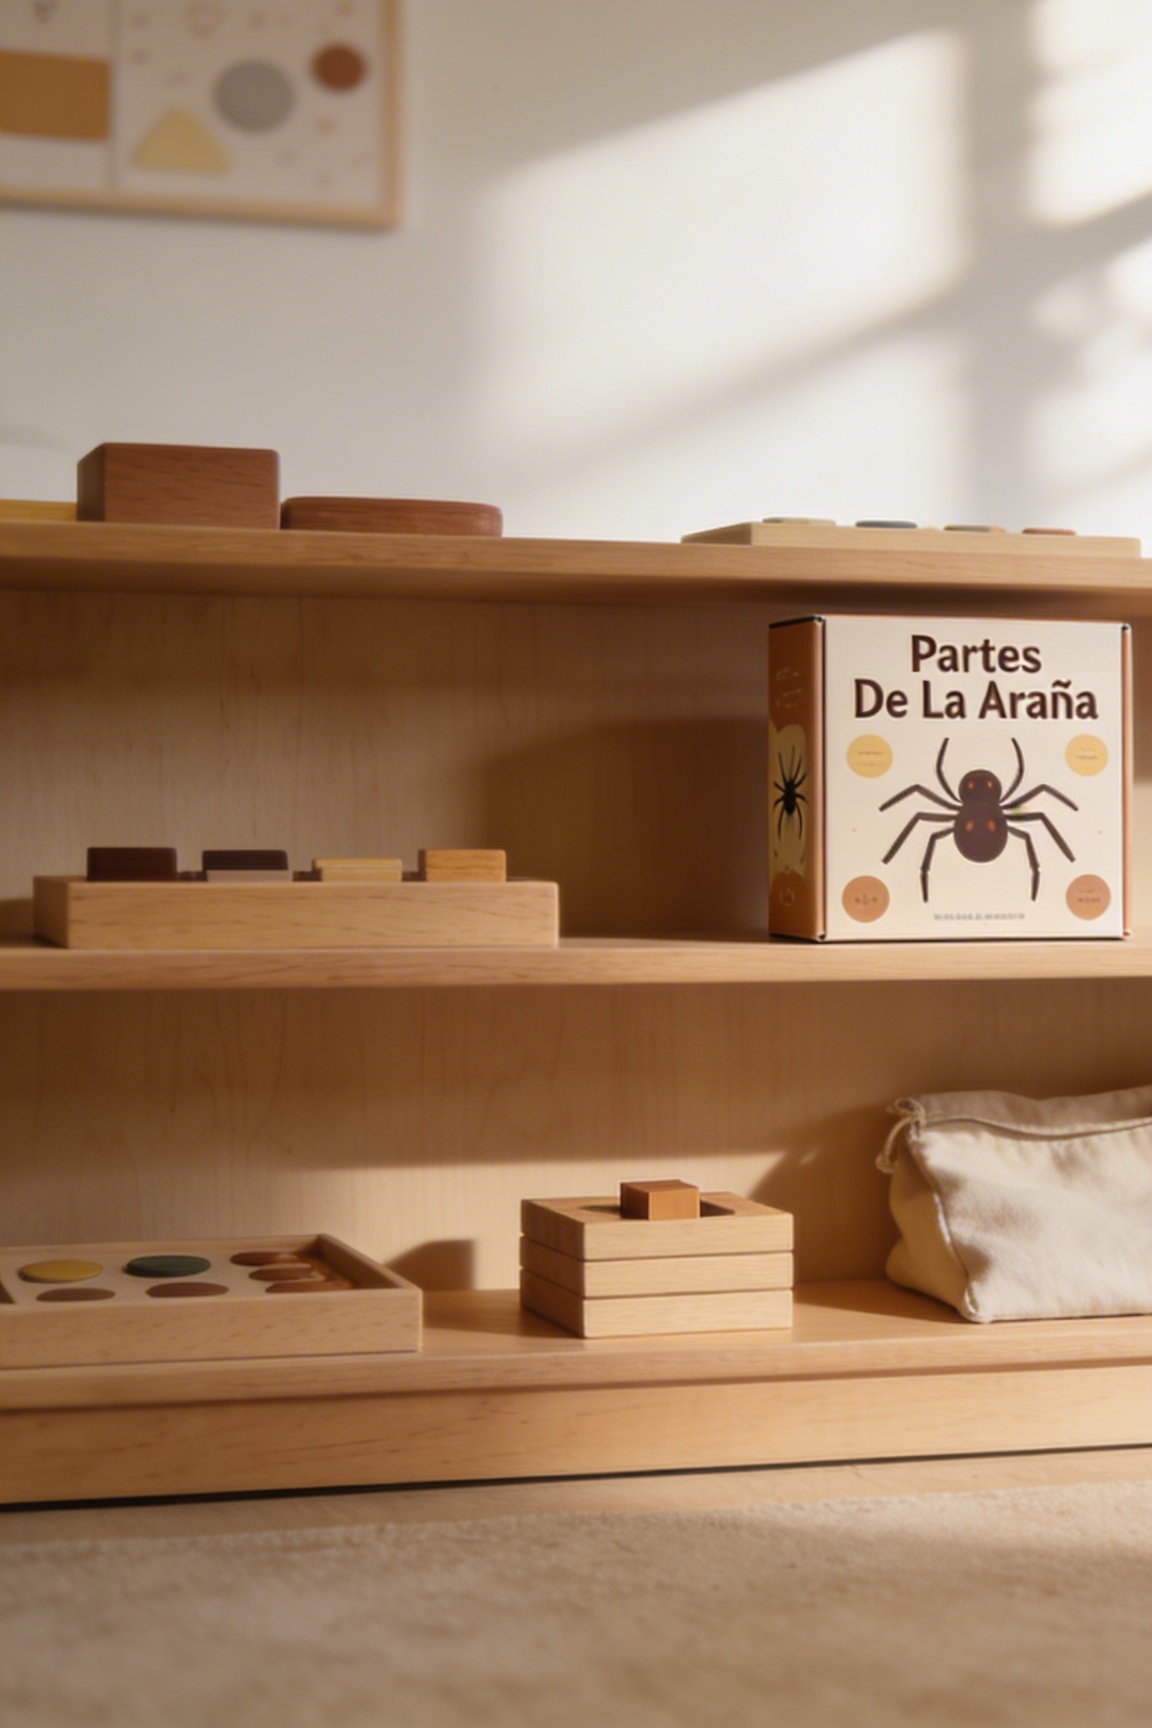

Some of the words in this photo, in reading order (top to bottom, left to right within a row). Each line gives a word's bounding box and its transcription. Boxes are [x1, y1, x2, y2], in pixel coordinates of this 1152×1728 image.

[911, 634, 1042, 674] Partes
[854, 678, 909, 719] De
[922, 679, 967, 719] La
[978, 679, 1099, 720] Araña
